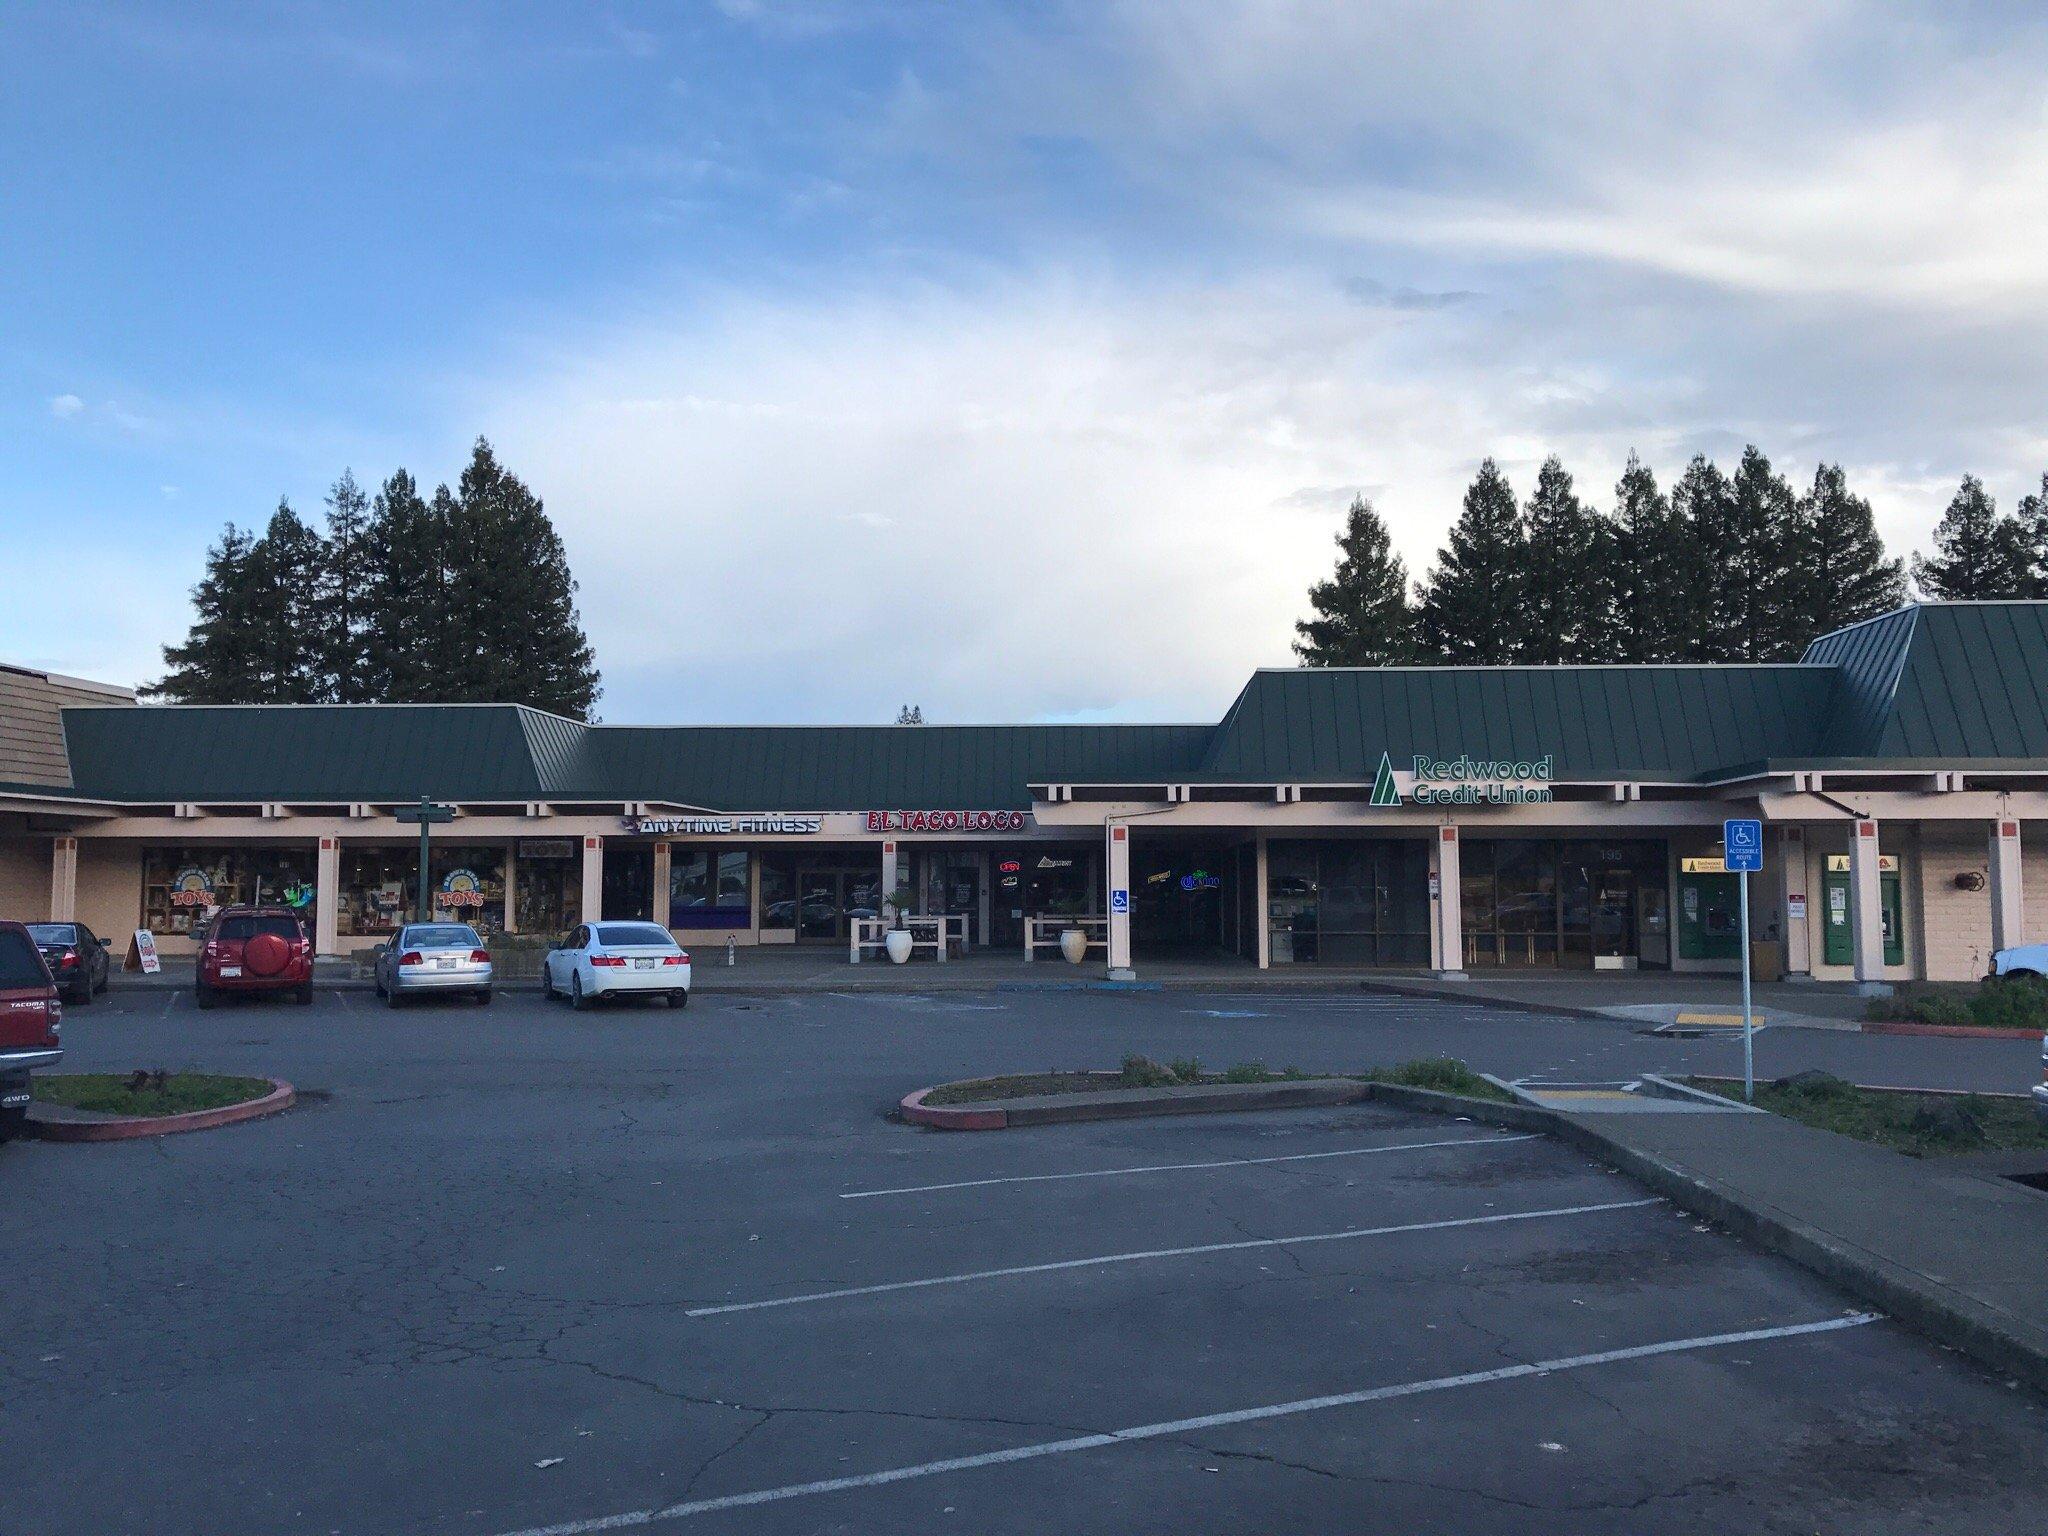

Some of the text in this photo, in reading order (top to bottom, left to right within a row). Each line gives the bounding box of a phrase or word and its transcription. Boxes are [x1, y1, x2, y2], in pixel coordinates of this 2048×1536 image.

[1412, 755, 1553, 781] Redwood
[1413, 784, 1553, 804] Credit Union
[640, 817, 822, 834] ANYTIME FITNESS
[867, 808, 1024, 831] EL TACO LOCO
[1600, 849, 1622, 861] 195
[171, 889, 215, 906] TOYS
[439, 890, 485, 907] TOYS
[3, 1094, 31, 1103] 4WD
